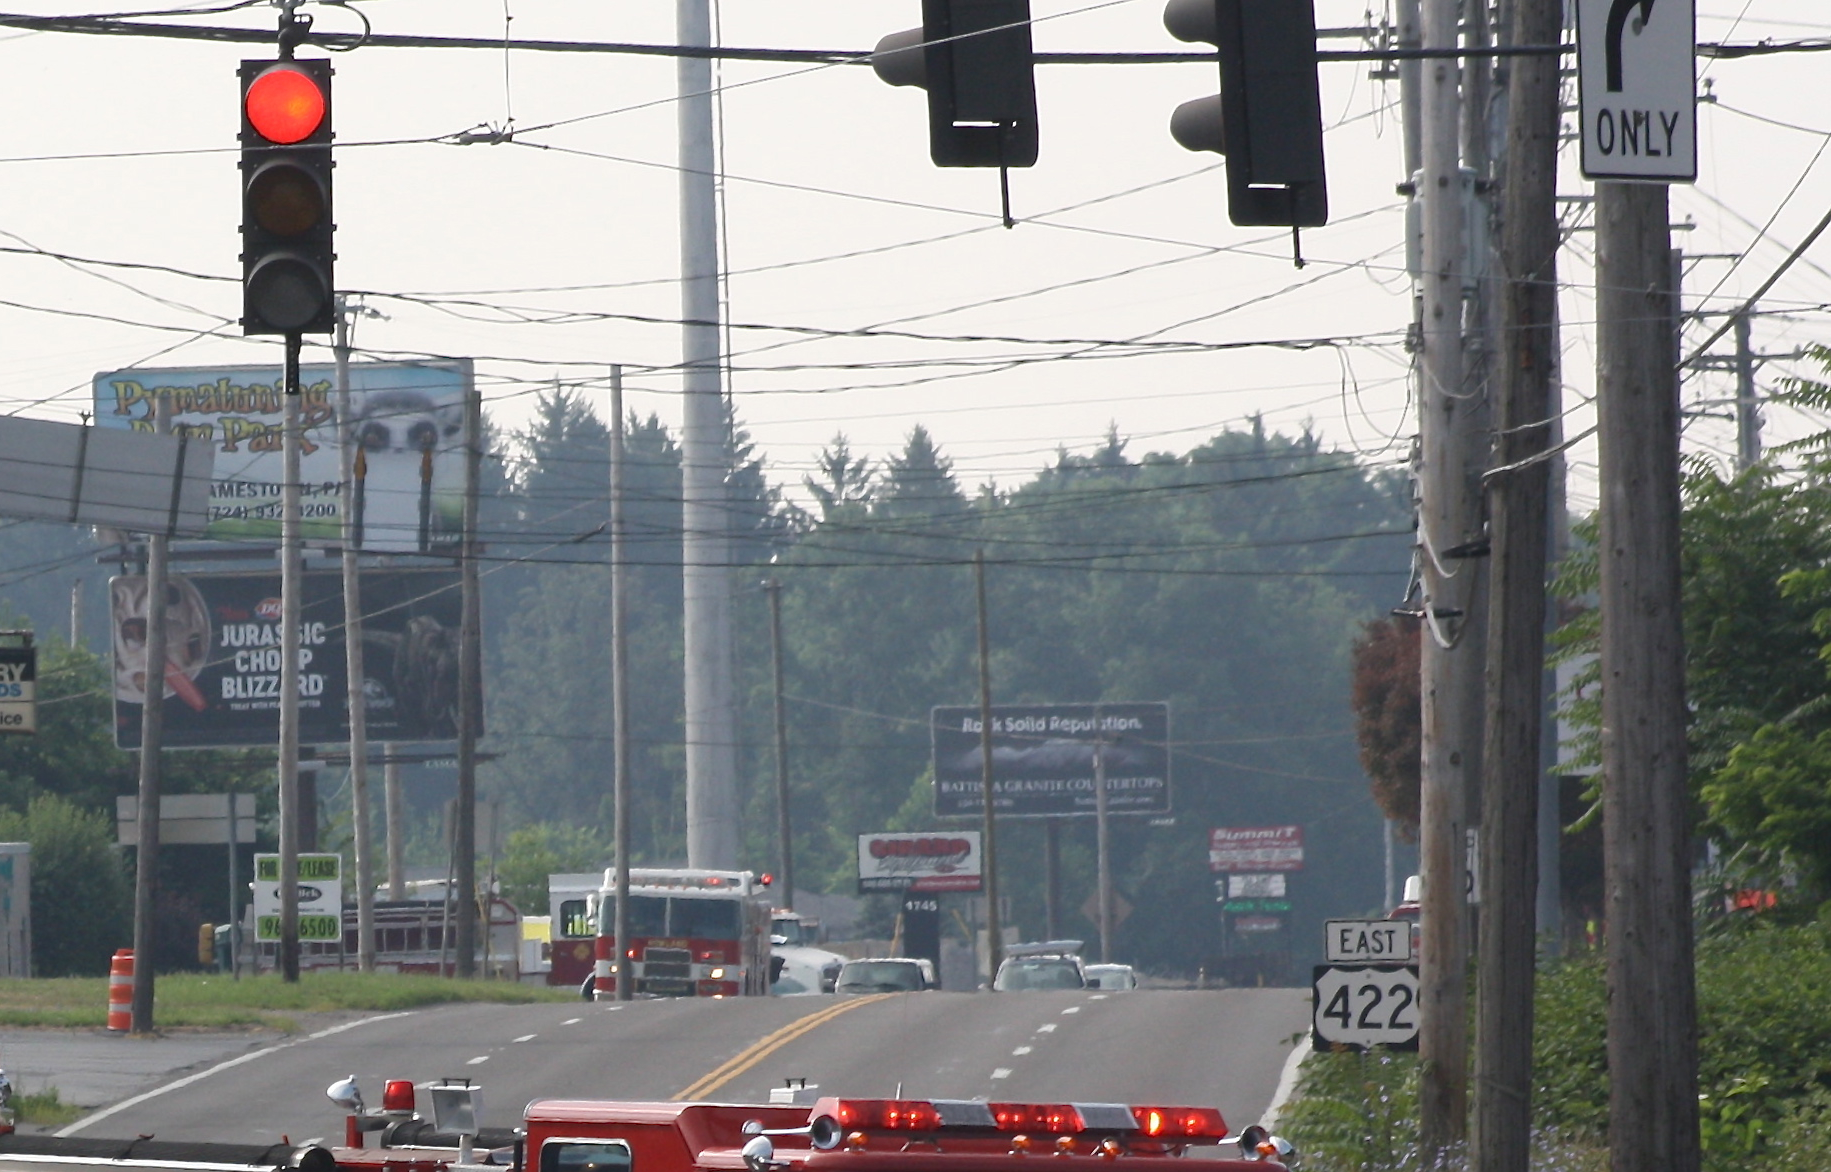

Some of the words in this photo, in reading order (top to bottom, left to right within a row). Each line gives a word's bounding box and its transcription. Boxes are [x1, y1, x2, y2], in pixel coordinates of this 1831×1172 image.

[1597, 108, 1679, 156] ONLY
[255, 503, 336, 518] 932200
[235, 648, 313, 673] CHOP
[221, 674, 324, 699] BLIZZRD
[962, 717, 1001, 733] Rok
[1005, 716, 1046, 733] Solid
[941, 780, 1002, 793] BATTISA
[1004, 780, 1064, 792] GRANITE
[1066, 777, 1163, 792] COUTERTOPS
[265, 918, 336, 937] 966500
[1339, 929, 1396, 954] EAST
[1323, 984, 1413, 1029] 422
